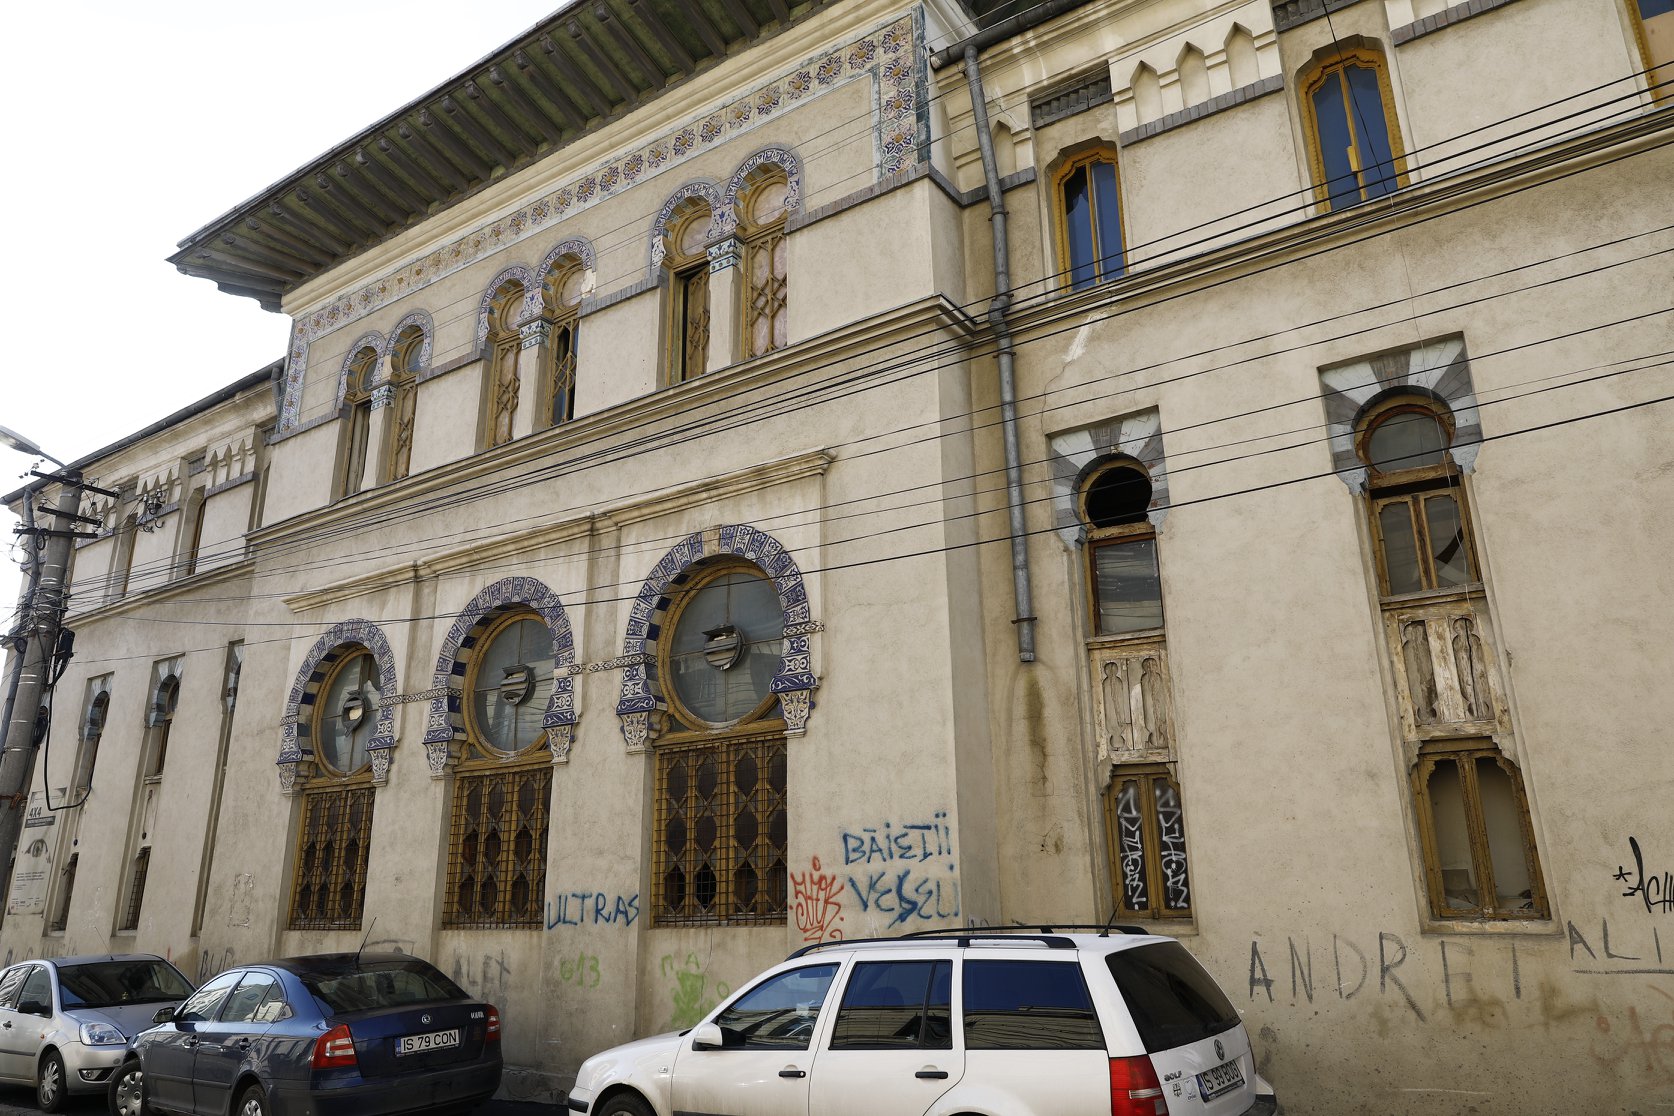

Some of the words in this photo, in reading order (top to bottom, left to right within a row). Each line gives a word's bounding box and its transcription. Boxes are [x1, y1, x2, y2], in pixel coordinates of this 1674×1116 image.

[547, 892, 640, 930] ULTRAS
[403, 1038, 414, 1052] IS
[418, 1035, 431, 1048] 79
[433, 1032, 457, 1046] CON
[1212, 1067, 1225, 1086] 99
